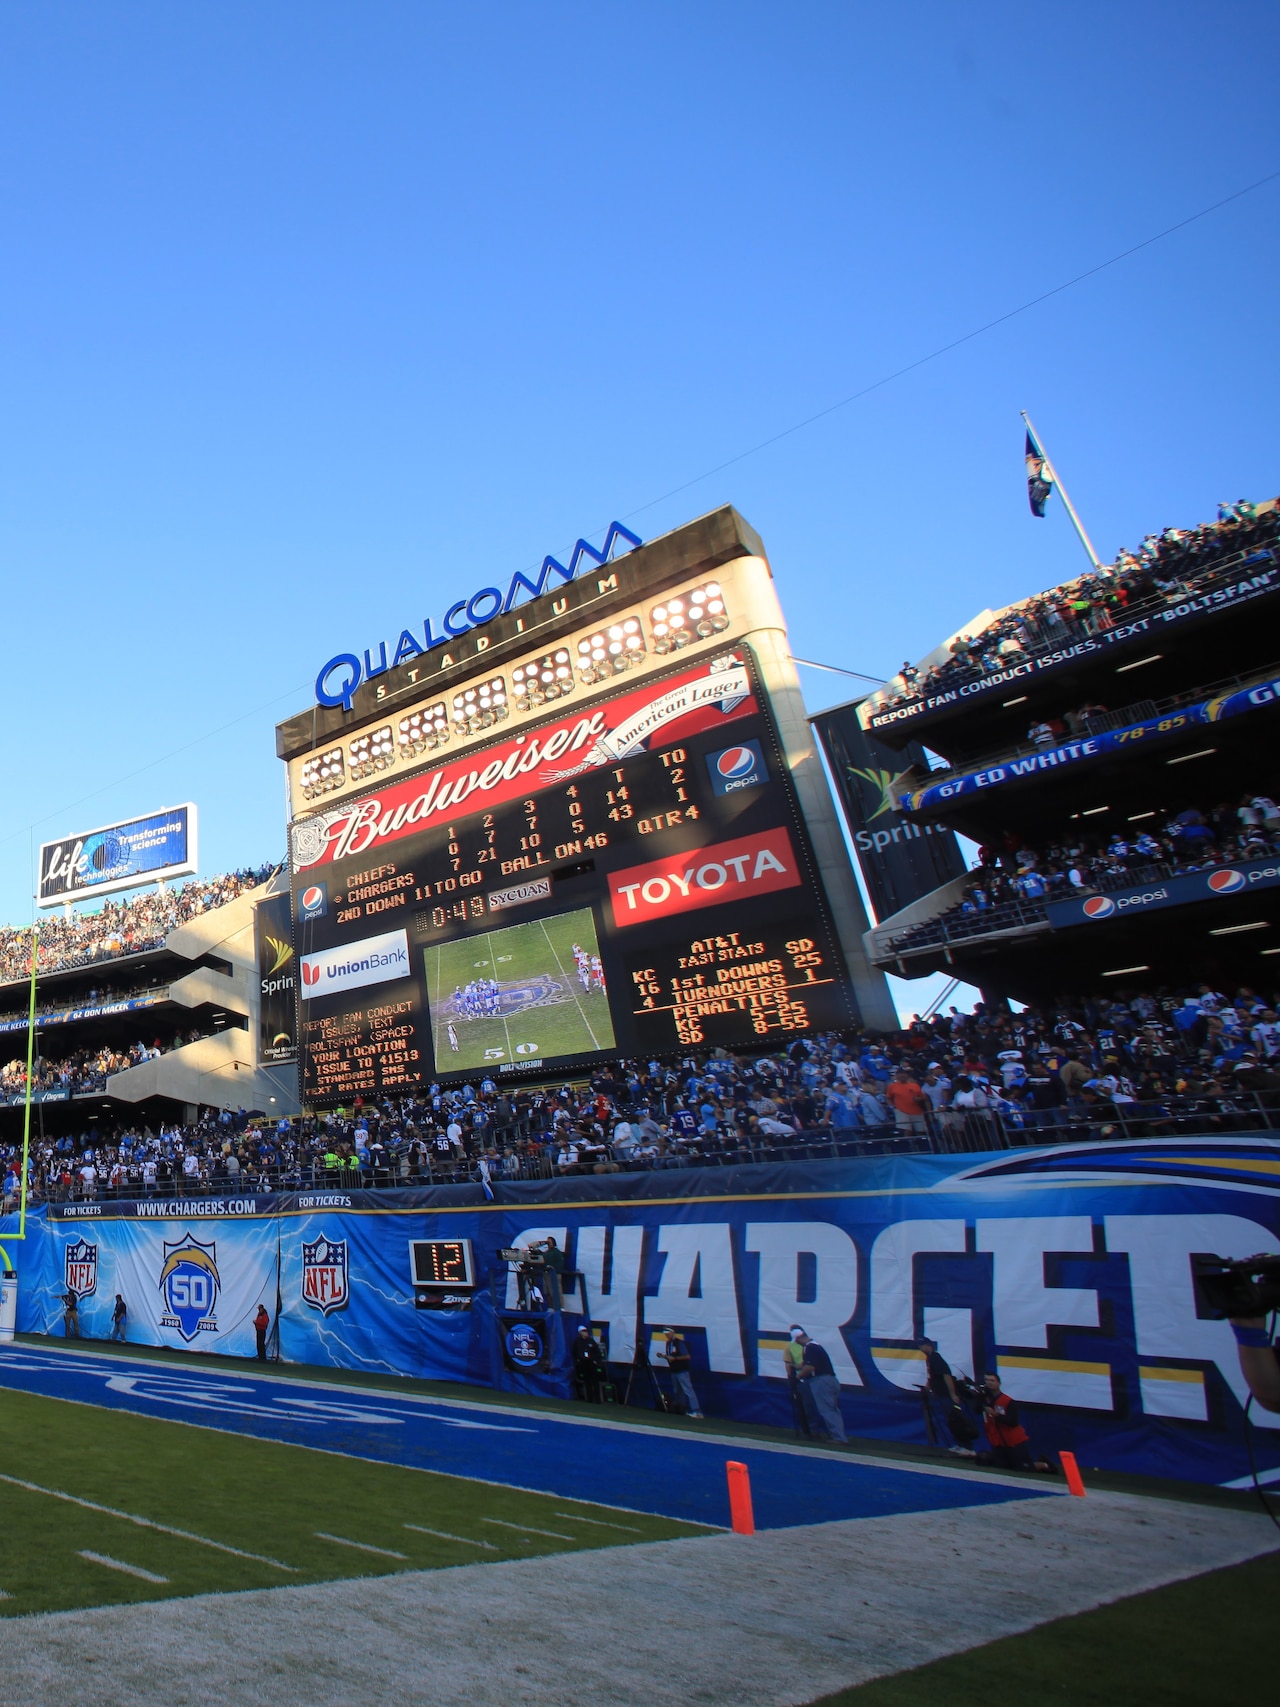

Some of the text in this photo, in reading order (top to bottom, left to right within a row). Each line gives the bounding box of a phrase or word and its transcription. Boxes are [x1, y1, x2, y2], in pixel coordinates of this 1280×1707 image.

[314, 520, 643, 712] QUALCOMM
[375, 573, 619, 698] STADIUM
[872, 701, 925, 728] REPORT
[928, 690, 958, 710] FAN
[959, 661, 1034, 697] CONDUCT
[1036, 638, 1102, 669] ISSUES,
[1103, 617, 1150, 643] TEXT
[649, 685, 689, 711] The Great
[616, 697, 687, 750] American
[692, 679, 743, 703] Lager
[612, 748, 688, 783] T TO
[938, 739, 1099, 798] 67 ED WHITE
[320, 710, 607, 861] Budweiser
[725, 773, 759, 792] pepsi
[447, 784, 578, 840] 1 2 3 4
[118, 821, 182, 847] Transforming
[346, 768, 685, 888] CHIEFS 0 7 7 0 14 2
[132, 836, 167, 852] science
[347, 787, 688, 904] CHARGERS 7 21 10 5 43 1
[42, 840, 89, 889] life
[74, 864, 129, 884] technologies
[336, 804, 700, 924] 2ND DOWN 11 TO GO BALL ON 46 QTR 4
[617, 849, 787, 910] TOYOTA
[488, 880, 550, 907] SYCUAN
[1116, 888, 1169, 910] pepsi
[303, 908, 323, 920] pepsi
[677, 942, 766, 969] FAST STATS
[690, 932, 740, 955] AT&T
[326, 948, 407, 980] UnionBank
[632, 937, 816, 984] KC SD
[637, 951, 823, 997] 16 1st DOWNS 25
[261, 974, 294, 996] Sprin
[642, 968, 817, 1009] 4 TURNOVERS 1
[84, 1008, 101, 1018] DON
[101, 1003, 129, 1015] MACEK
[302, 1000, 413, 1032] REPORT FAN CONDUCT
[673, 989, 790, 1020] PENALTIES
[675, 1000, 808, 1033] KC 5-25
[321, 1015, 394, 1039] ISSUES, TEXT
[370, 1024, 415, 1042] (SPACE)
[677, 1013, 810, 1045] SD 8-55
[312, 1038, 407, 1064] YOUR LOCATION
[316, 1049, 419, 1076] ISSUE TO 41513
[305, 1072, 422, 1096] TEXT RATES APPLY
[317, 1064, 406, 1085] STANDARD SMS
[63, 1206, 102, 1216] FOR TICKETS
[137, 1199, 256, 1217] WWW.CHARGERS.COM
[298, 1195, 352, 1207] FOR TICKETS
[431, 1243, 462, 1281] 12
[68, 1263, 94, 1289] NFL
[304, 1268, 343, 1305] NFL
[171, 1274, 208, 1310] 50
[199, 1322, 215, 1330] 2009
[513, 1333, 535, 1343] NFL
[514, 1348, 536, 1357] CBS
